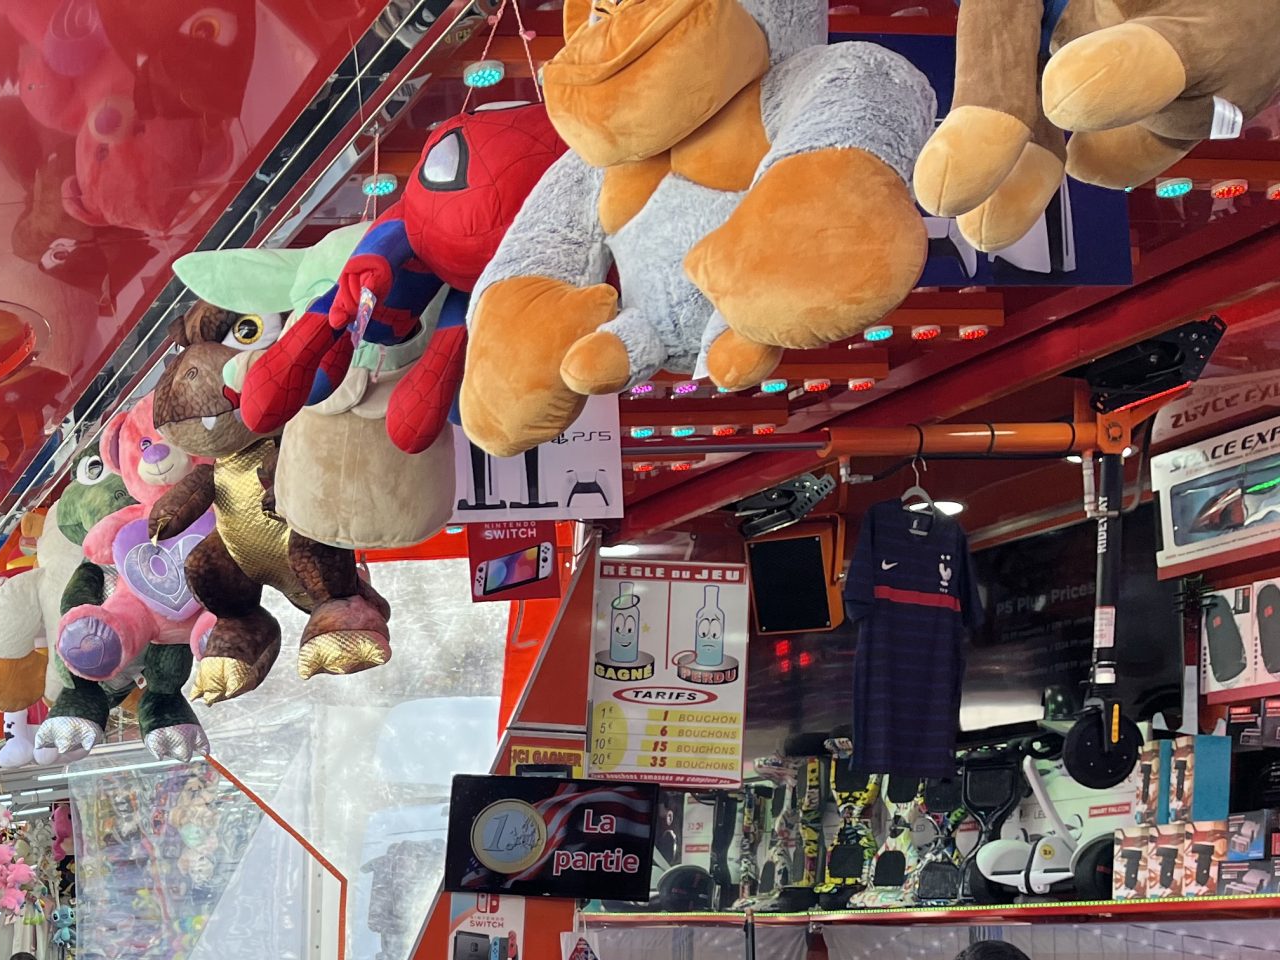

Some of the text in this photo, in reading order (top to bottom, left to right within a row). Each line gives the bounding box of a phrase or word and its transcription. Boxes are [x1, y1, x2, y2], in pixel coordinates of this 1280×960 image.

[572, 431, 612, 442] PS5
[484, 528, 537, 540] SWITCH
[671, 570, 691, 579] DU
[694, 569, 740, 581] JEU
[1017, 595, 1046, 613] Plu
[1051, 584, 1095, 603] Prices
[595, 663, 654, 681] GAGNÉ
[680, 668, 737, 684] PERDU
[632, 690, 698, 701] TARIFS
[662, 710, 670, 721] 1
[678, 713, 737, 724] BOUCHON
[660, 725, 668, 737] 6
[677, 728, 737, 739] BOUCHONS
[652, 741, 668, 752] 15
[676, 744, 736, 755] BOUCHONS
[533, 750, 582, 767] GAGNER
[650, 756, 667, 767] 35
[675, 760, 735, 770] BOUCHONS
[584, 808, 616, 834] La
[553, 848, 640, 876] partie
[470, 920, 504, 928] SWITCH
